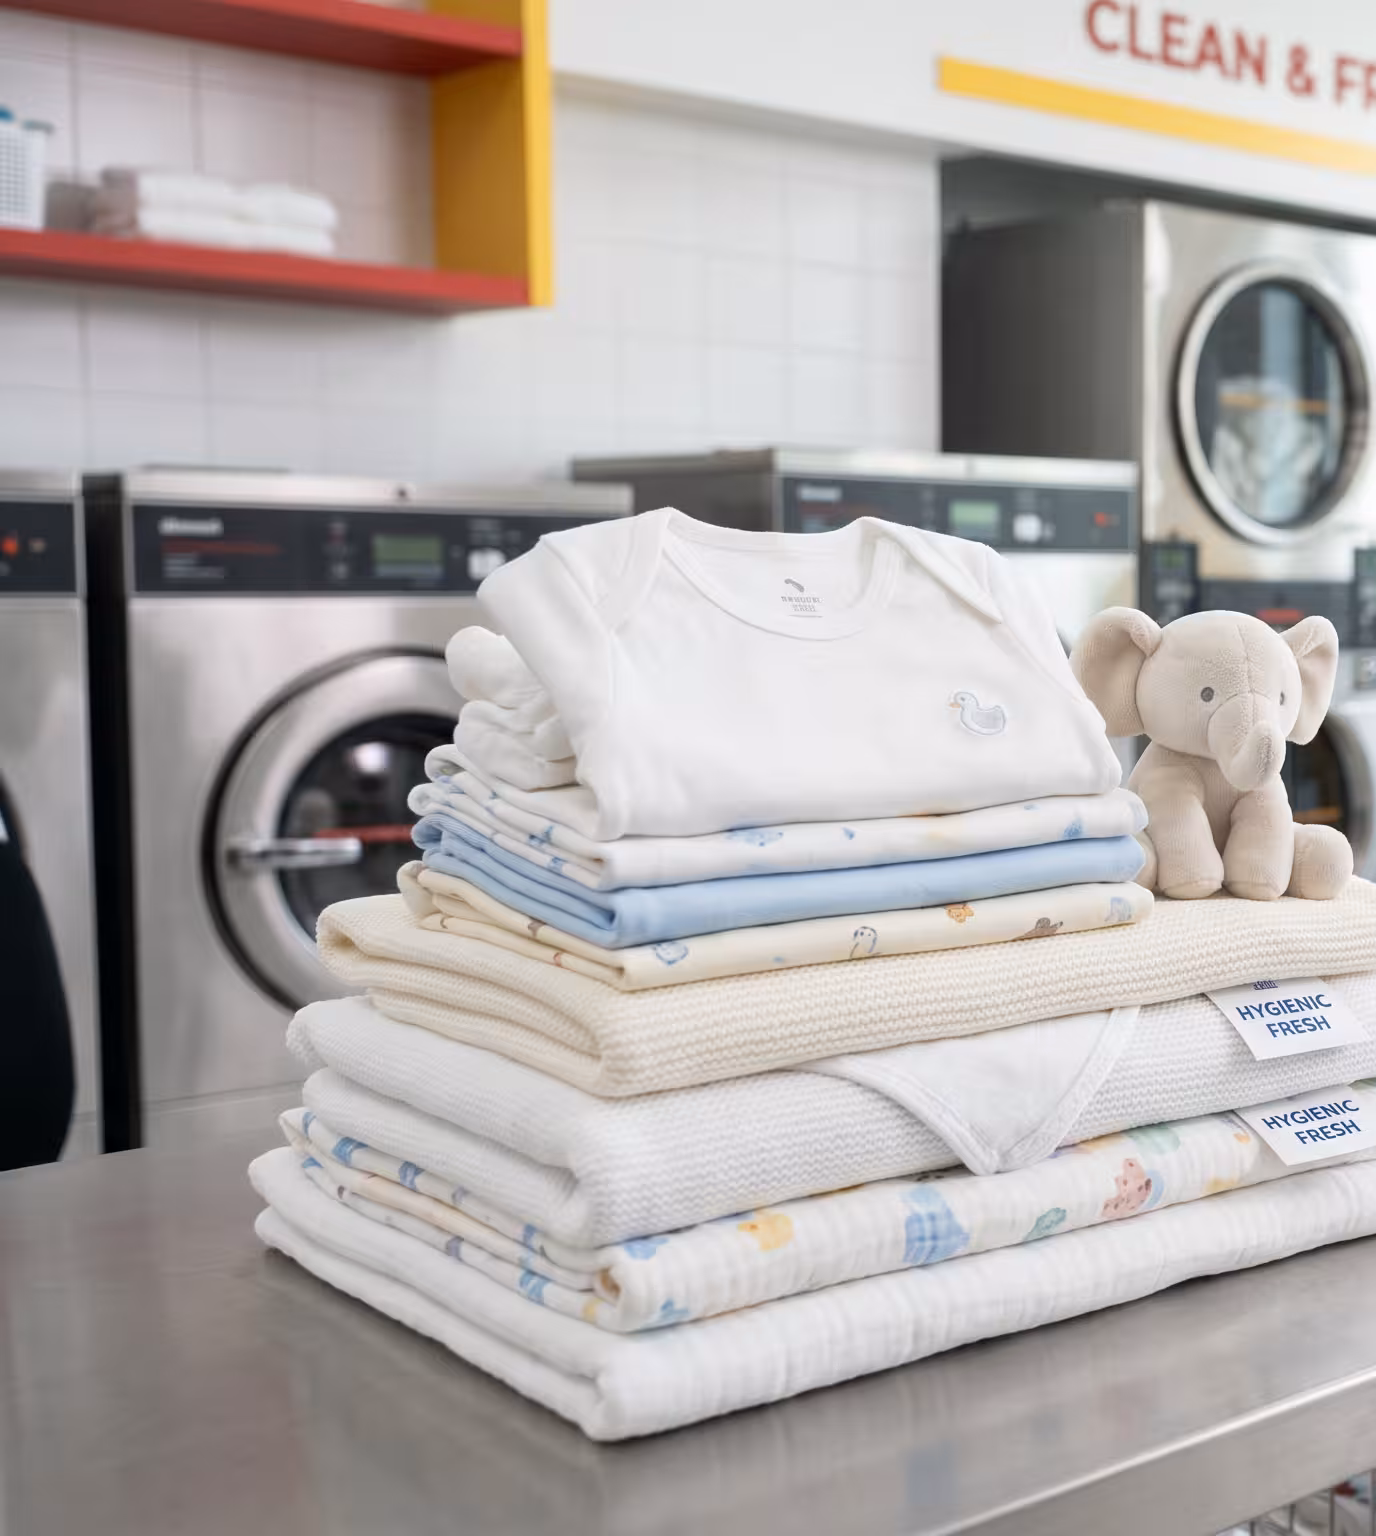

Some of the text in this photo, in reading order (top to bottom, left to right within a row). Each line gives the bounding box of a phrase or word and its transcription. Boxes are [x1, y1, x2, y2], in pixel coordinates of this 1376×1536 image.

[1086, 0, 1267, 86] CLEAN
[1287, 44, 1315, 97] &
[1236, 994, 1332, 1020] HYGIENIC
[1266, 1015, 1332, 1038] FRESH
[1261, 1099, 1360, 1130] HYGIENIC
[1294, 1119, 1362, 1145] FRESH
